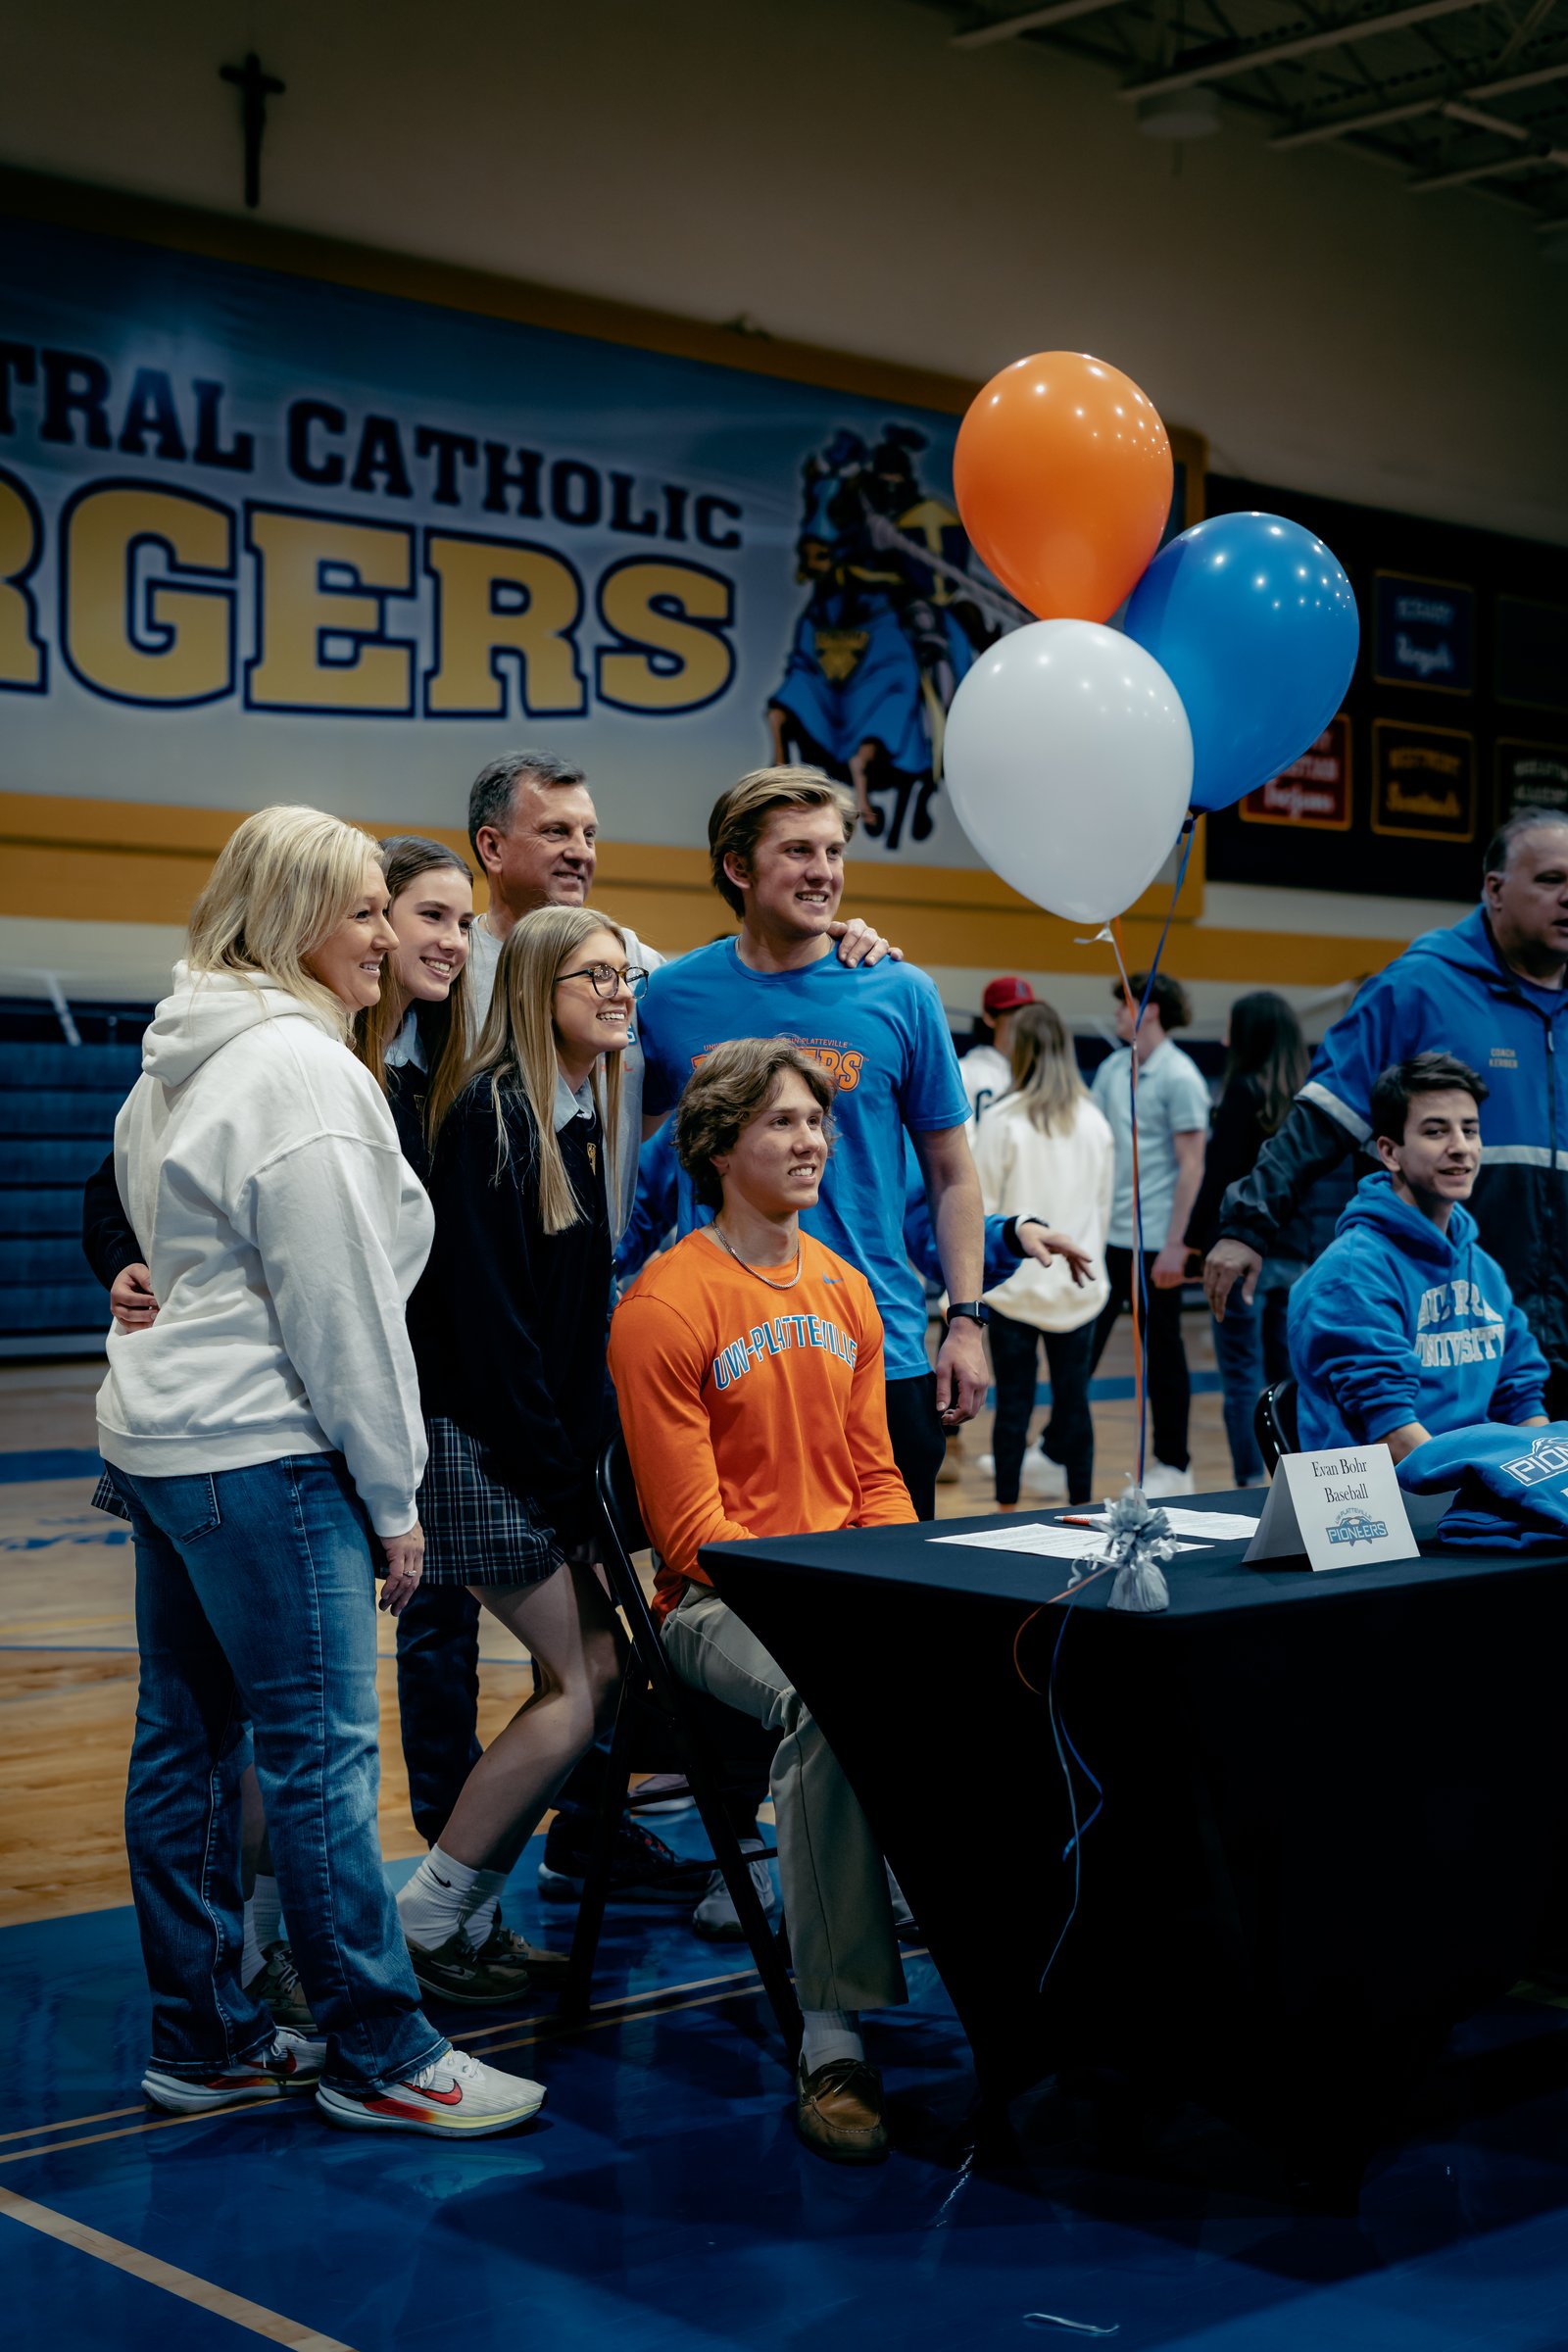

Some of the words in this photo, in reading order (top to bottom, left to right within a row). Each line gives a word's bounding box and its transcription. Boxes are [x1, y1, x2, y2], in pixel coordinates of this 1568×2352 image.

[287, 397, 743, 551] CATHOLIC
[0, 466, 736, 719] GERS
[1311, 1461, 1339, 1477] Evan
[1340, 1457, 1367, 1475] Bohr
[1324, 1483, 1369, 1503] Baseball
[1328, 1523, 1388, 1543] PIONEERS
